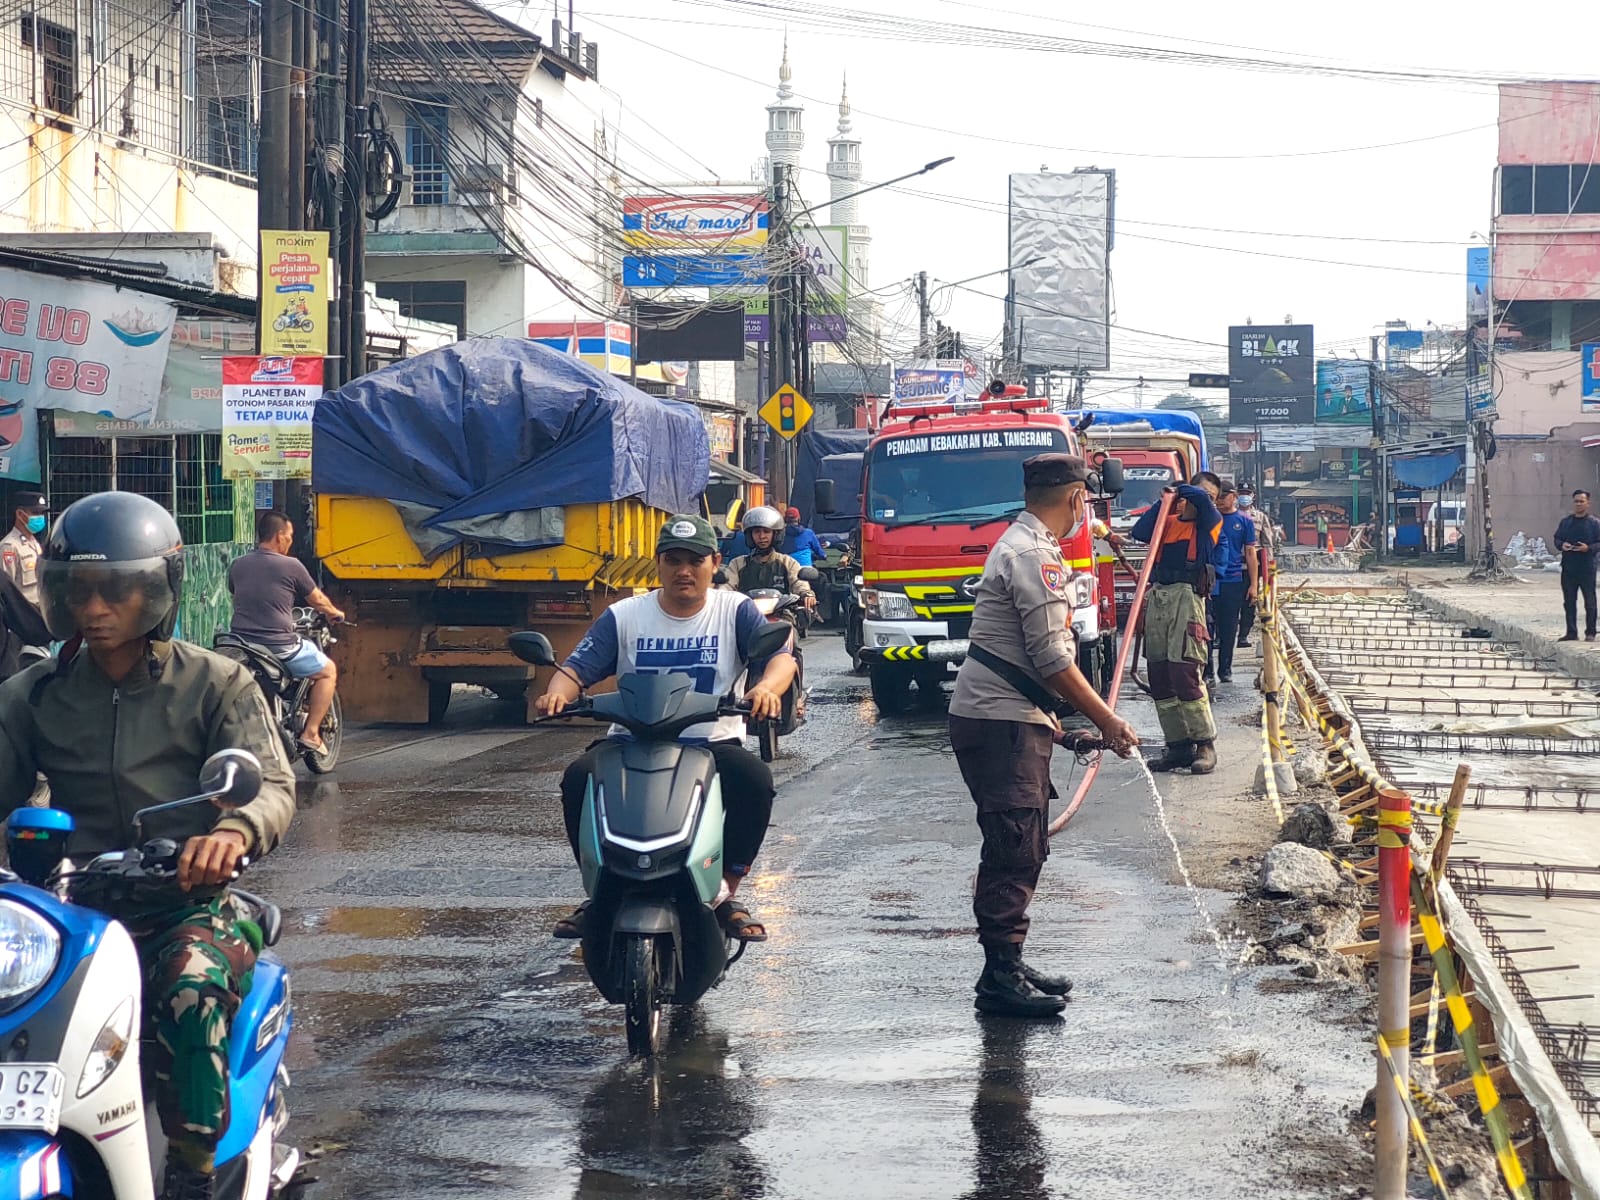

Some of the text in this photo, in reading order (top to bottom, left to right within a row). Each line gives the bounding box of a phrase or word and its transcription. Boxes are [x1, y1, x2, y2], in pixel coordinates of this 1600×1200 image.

[651, 212, 750, 230] Indomaret
[276, 236, 315, 247] maxim
[281, 254, 308, 262] Pesan
[271, 263, 318, 274] perjalanan
[281, 274, 307, 284] cepat
[1241, 334, 1300, 357] BLACK
[45, 355, 111, 396] 88
[242, 388, 306, 398] PLANET BAN
[900, 383, 950, 397] GUDANG
[226, 399, 266, 407] OTONOM
[267, 399, 294, 407] PASAR
[235, 410, 309, 421] TETAP BUKA
[1261, 408, 1289, 416] 17.000
[228, 434, 259, 446] Home
[886, 431, 1053, 457] PEMADAM KEBAKARAN KAB. TANGERANG
[233, 443, 271, 455] Service
[70, 553, 108, 561] HONDA
[96, 1100, 136, 1125] YAMAHA
